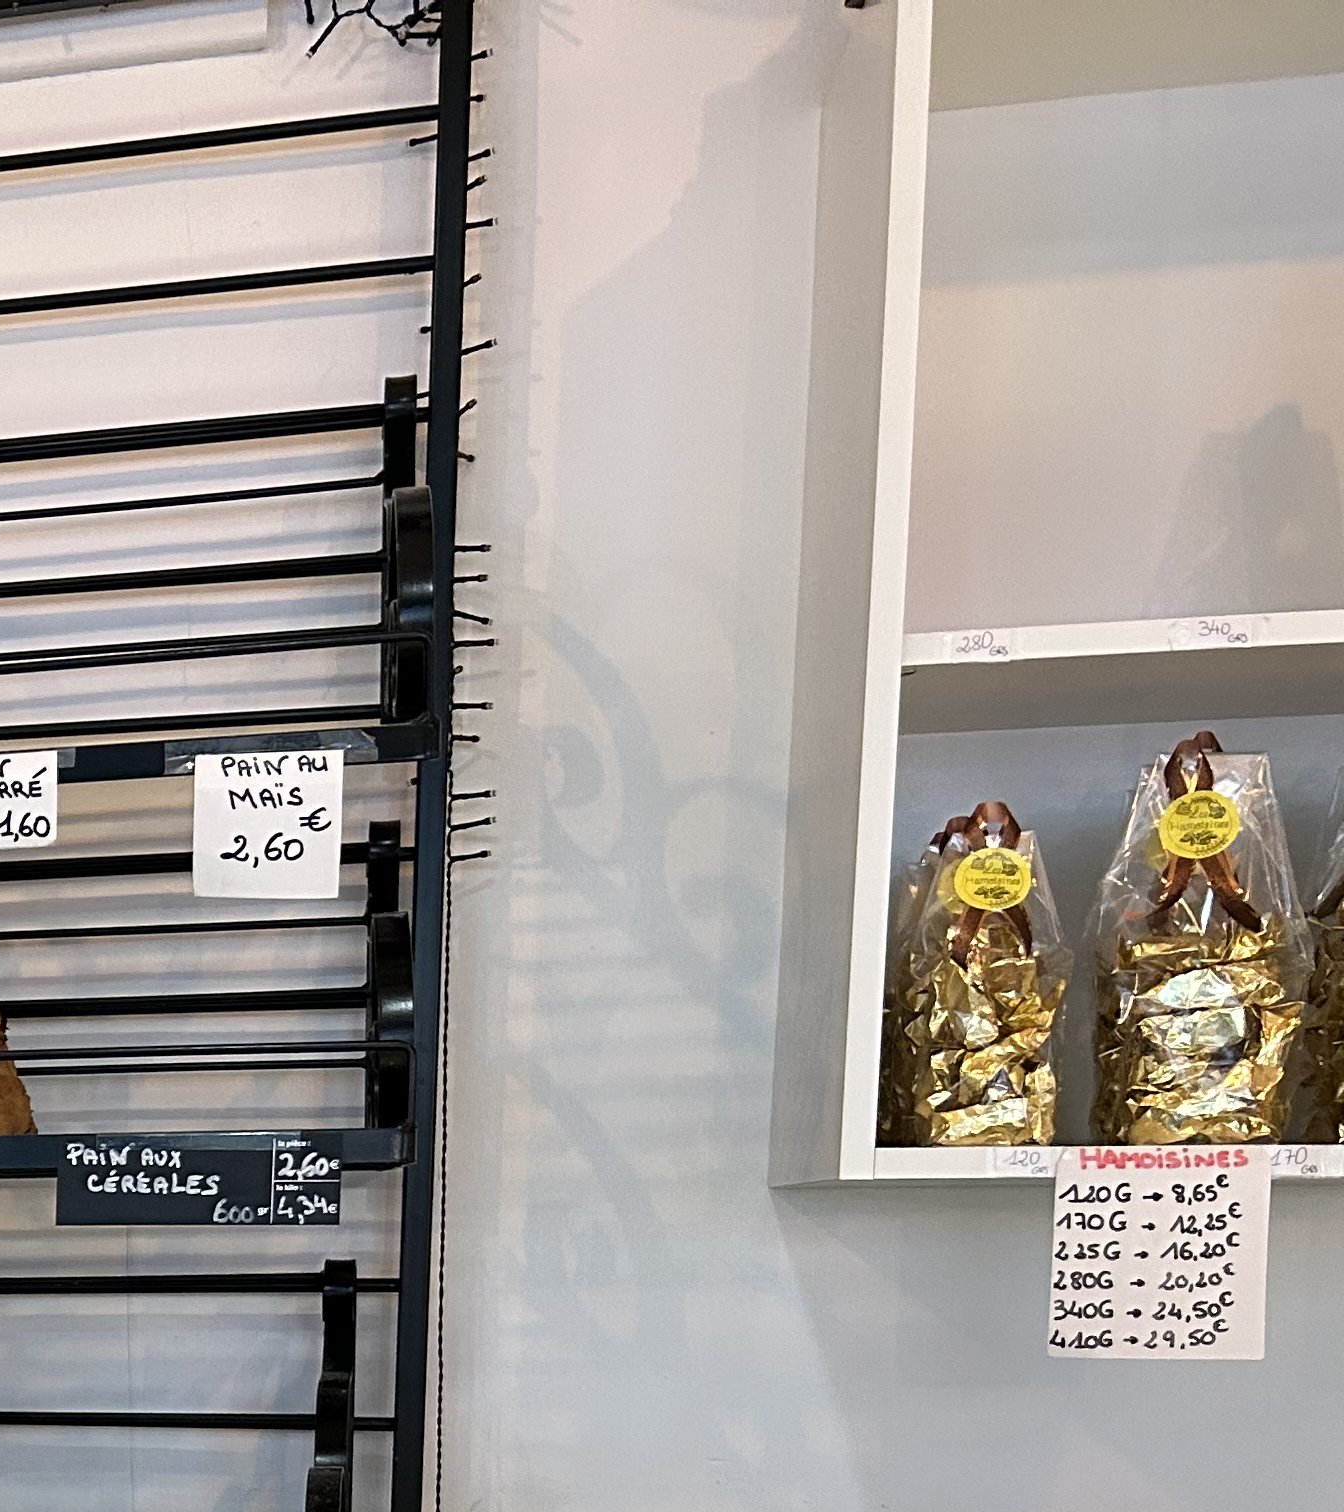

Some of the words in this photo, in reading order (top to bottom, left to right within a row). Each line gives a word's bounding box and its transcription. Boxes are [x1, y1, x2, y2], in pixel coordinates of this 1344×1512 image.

[1198, 619, 1231, 636] 340
[956, 631, 994, 653] 280
[297, 755, 328, 772] AU
[141, 1148, 181, 1169] AUX
[1002, 1150, 1040, 1166] 120
[1271, 1147, 1308, 1166] 170
[87, 1170, 220, 1196] CÉRÉALES
[213, 1198, 255, 1224] 600
